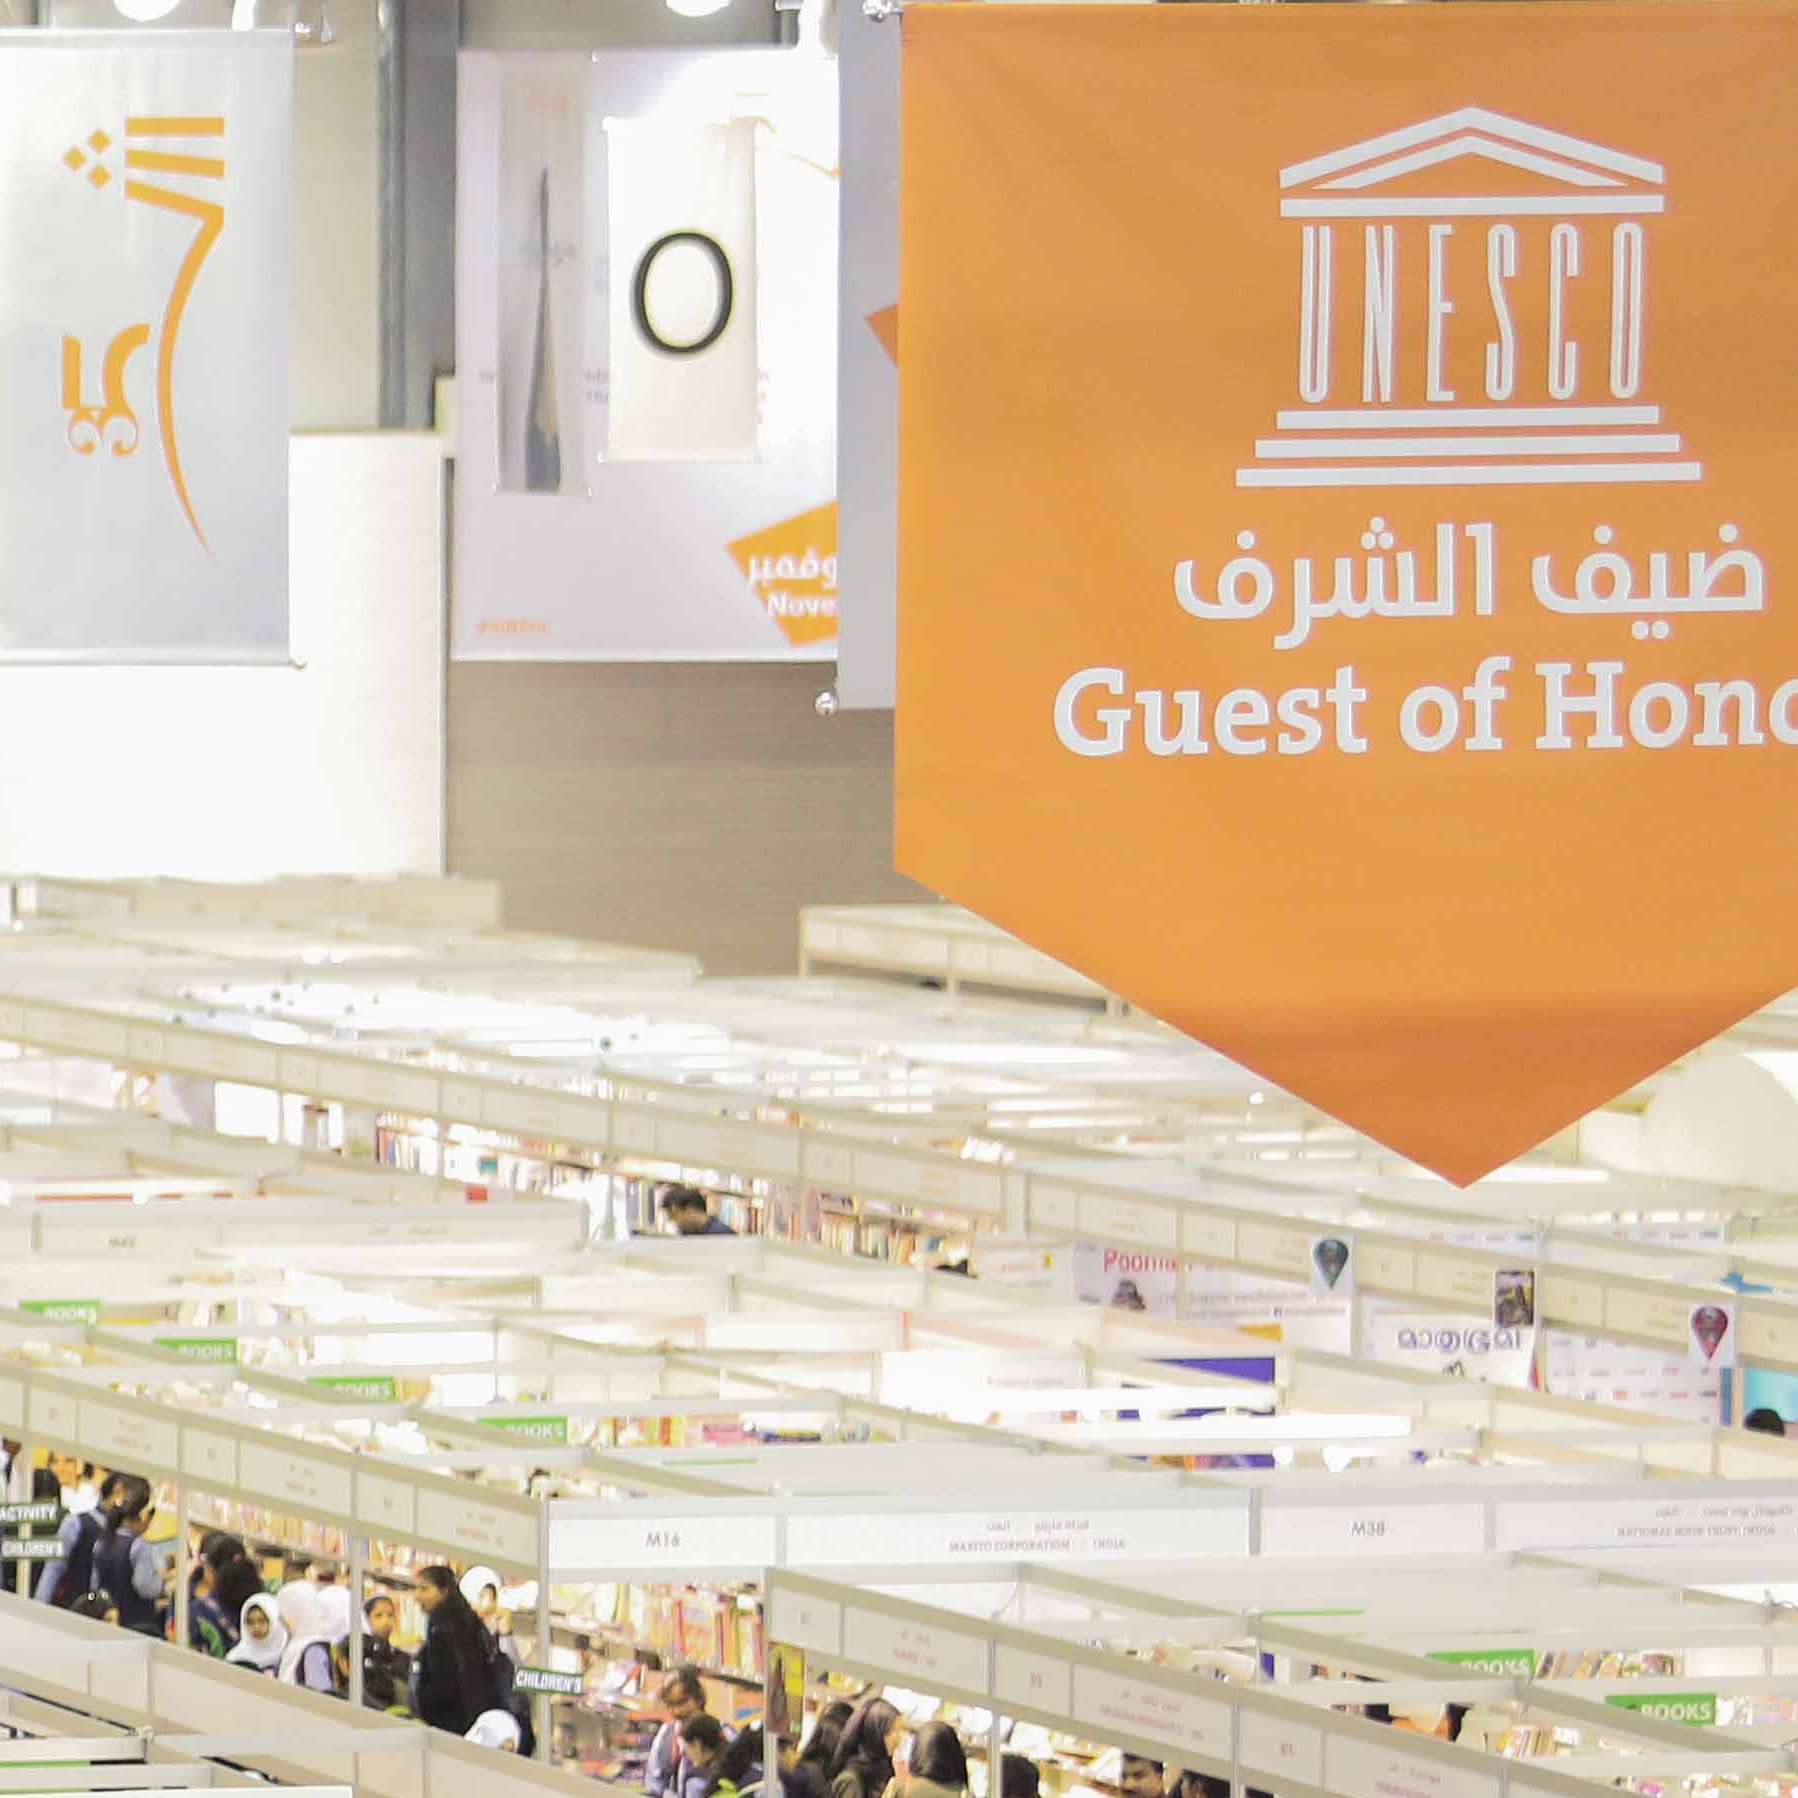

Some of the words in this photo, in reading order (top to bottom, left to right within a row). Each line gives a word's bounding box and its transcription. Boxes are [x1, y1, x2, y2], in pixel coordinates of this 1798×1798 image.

[630, 230, 734, 354] O
[1299, 222, 1642, 403] UNESCO
[765, 592, 837, 618] Nove
[1173, 516, 1494, 650] الشرف
[1530, 522, 1764, 640] ضيف
[1052, 665, 1367, 756] Guest
[1399, 656, 1510, 753] of
[644, 1532, 680, 1548] M16
[1463, 1659, 1529, 1677] OOKS
